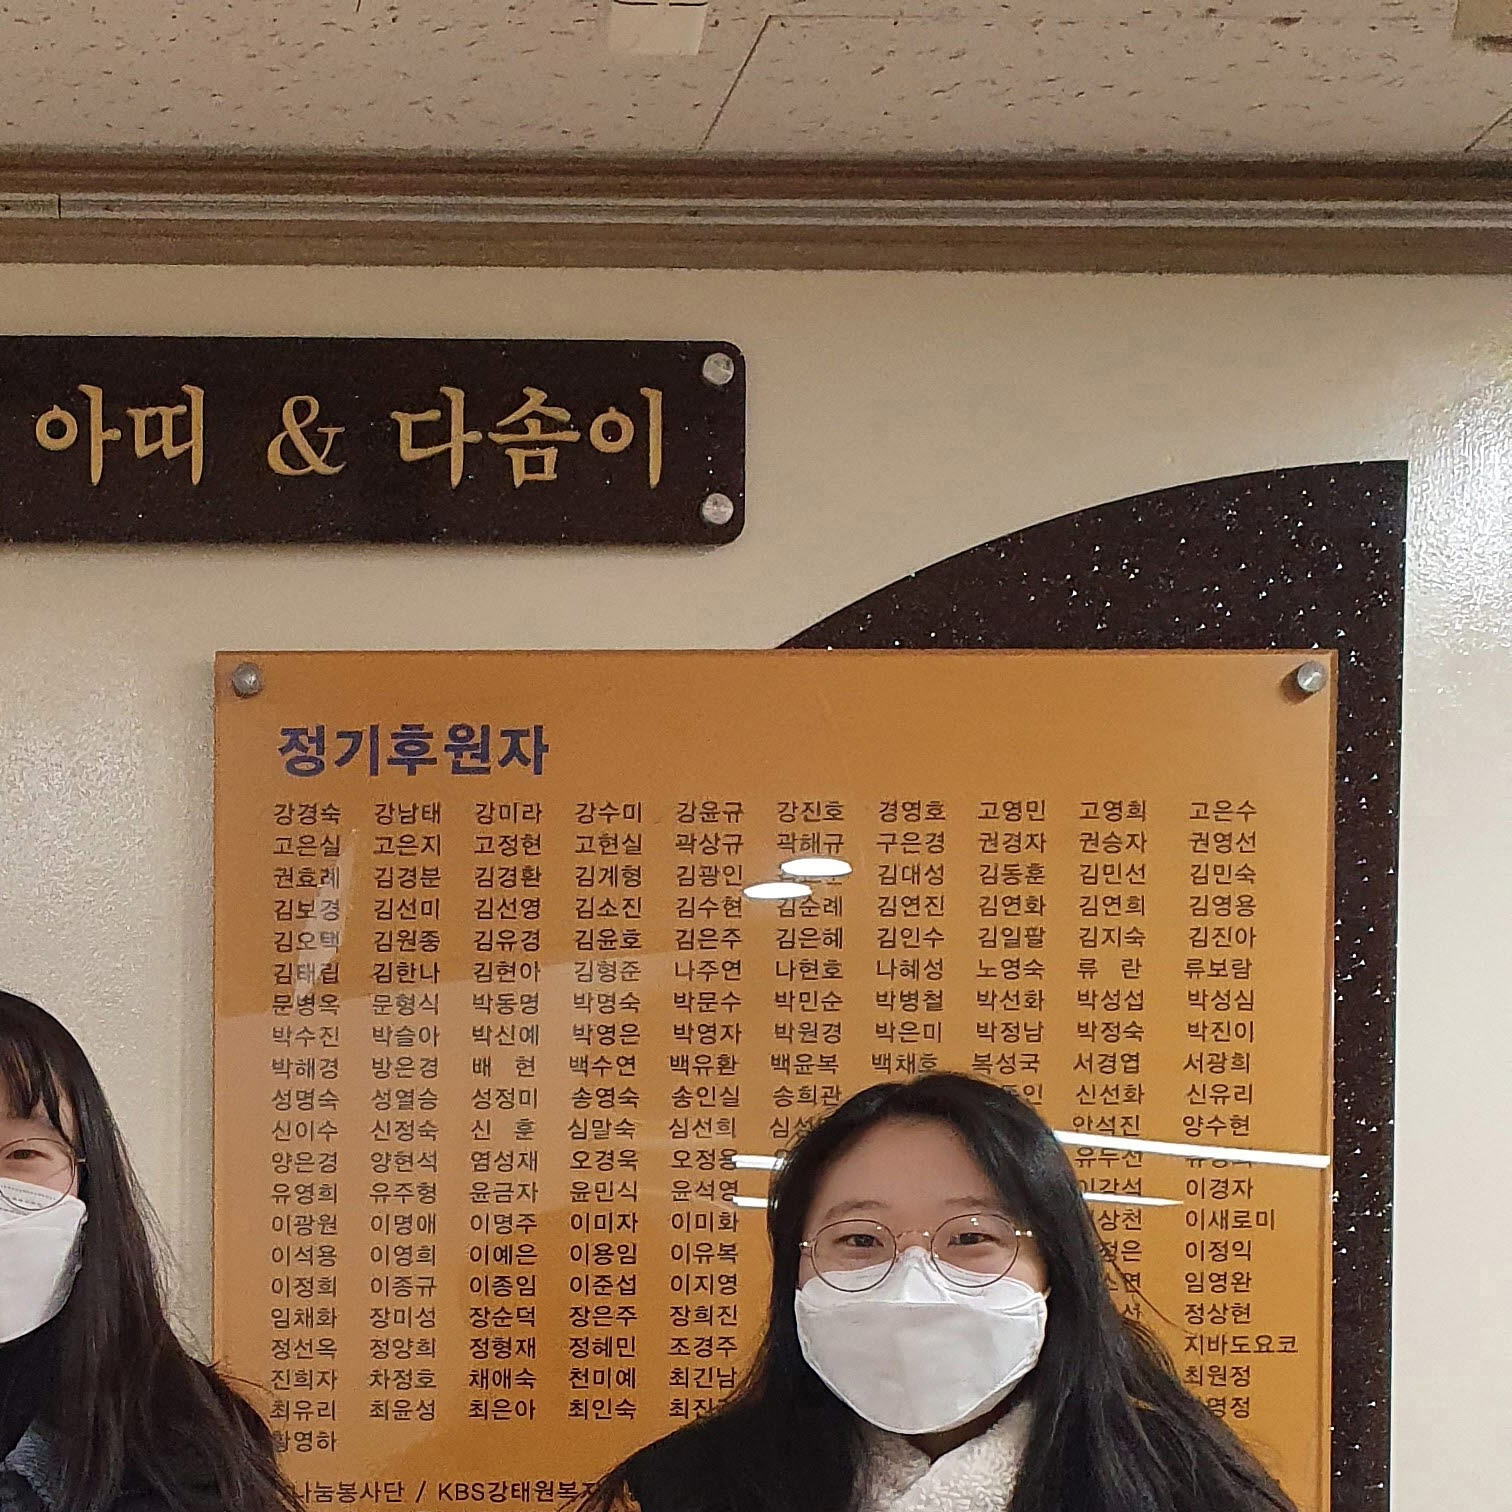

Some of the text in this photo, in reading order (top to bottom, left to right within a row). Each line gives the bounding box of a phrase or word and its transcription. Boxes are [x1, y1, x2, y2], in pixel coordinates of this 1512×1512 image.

[35, 383, 205, 486] 아띠
[268, 394, 346, 476] &
[391, 386, 663, 489] 다솜이
[277, 723, 549, 777] 정기후원자
[274, 800, 1257, 825] 강경숙 강남태 강미라 강수미 강윤규 강진호 경영호 고영민 고영희 고은수
[273, 834, 340, 857] 고은실
[373, 834, 440, 856] 고은지
[474, 833, 541, 857] 고정현
[575, 833, 642, 855] 고현실
[675, 832, 744, 856] 곽상규
[876, 831, 944, 854] 구은경
[978, 831, 1047, 853] 권경자
[1079, 831, 1147, 854] 권승자
[1188, 831, 1256, 854] 권영선
[374, 930, 440, 952] 김원종
[474, 929, 540, 952] 김유경
[574, 928, 642, 950] 김윤호
[676, 928, 743, 950] 김은주
[776, 926, 842, 949] 김은혜
[877, 926, 944, 948] 김인수
[1079, 926, 1146, 948] 김지숙
[1189, 926, 1257, 949] 김진아
[373, 993, 438, 1016] 문형식
[473, 992, 538, 1015] 박동명
[574, 992, 640, 1014] 박명숙
[674, 991, 741, 1013] 박문수
[774, 990, 843, 1013] 박민순
[876, 990, 943, 1012] 박병철
[977, 990, 1045, 1011] 박선화
[1078, 989, 1143, 1011] 박성섭
[1188, 989, 1254, 1011] 박성심
[273, 1020, 1254, 1047] 박수진 박슬아 박신예 박영은 박영자 박원경 박은미 박정남 박정숙 박진이
[272, 1209, 1274, 1236] 이광원 이명애 이명주 이미자 이미화 이새로미
[272, 1240, 1251, 1267] 이석용 이영희 이예은 이용임 이유복 이정익
[272, 1271, 1252, 1298] 이정희 이종규 이종임 이준섭 이지영 임영완
[271, 1303, 1251, 1328] 임채화 장미성 장순덕 장은주 장희진 정상현
[272, 1334, 1298, 1360] 정선옥 정양희 정형재 정혜민 조경주 지바도요코
